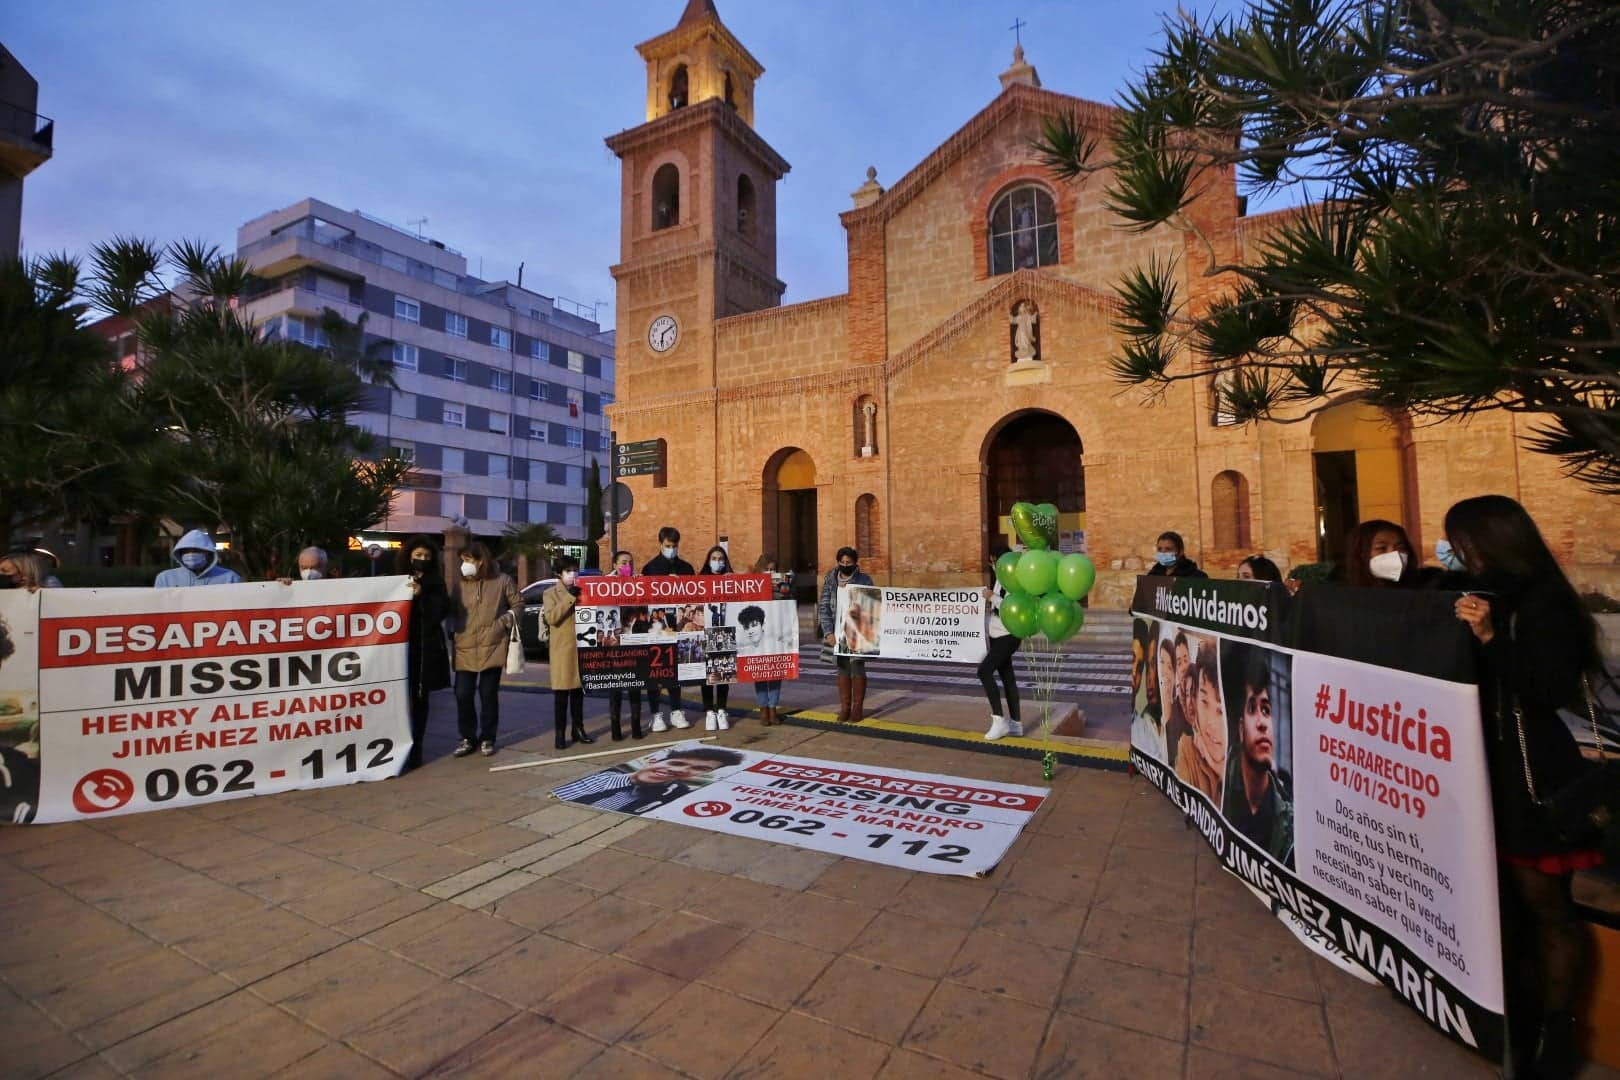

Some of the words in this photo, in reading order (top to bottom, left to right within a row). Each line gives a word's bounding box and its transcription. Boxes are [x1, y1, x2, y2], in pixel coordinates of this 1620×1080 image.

[586, 581, 645, 597] TODOS
[650, 580, 707, 596] SOMOS
[712, 579, 765, 594] HENRY
[886, 591, 979, 603] DESAPARECIDO
[886, 603, 932, 614] MISSING
[934, 604, 979, 615] PERSON
[57, 610, 402, 657] DESAPARECIDO
[904, 616, 960, 626] 01/01/2019
[908, 629, 949, 637] ALEJANDRO
[114, 651, 362, 702] MISSING
[650, 646, 675, 666] 21
[743, 664, 775, 672] ORIHUELA
[775, 662, 796, 670] COSTA
[747, 655, 792, 664] DESAPARECIDO
[82, 707, 200, 736] HENRY
[210, 688, 387, 723] ALEJANDRO
[1315, 683, 1452, 762] #Justicia
[112, 727, 258, 759] JIMÉNEZ
[269, 714, 364, 742] MARÍN
[145, 760, 255, 802] 062
[269, 769, 287, 780] -
[302, 738, 394, 780] 112
[758, 762, 1027, 806] DESAPARECIDO
[1319, 734, 1440, 798] DESARARECIDO
[731, 785, 811, 803] HENRY
[818, 799, 984, 831] ALEJANDRO
[767, 778, 972, 815] MISSING
[1330, 762, 1426, 819] 01/01/2019
[729, 809, 826, 836] 062
[866, 833, 972, 863] 112
[853, 814, 949, 838] MARÍN
[1335, 799, 1354, 820] Dos
[1357, 811, 1384, 834] años
[1387, 824, 1406, 843] sin
[1409, 833, 1424, 853] ti,
[1316, 810, 1325, 824] tu
[1327, 817, 1363, 846] madre,
[1365, 834, 1384, 854] tus
[1387, 842, 1453, 894] hermanos,
[1333, 840, 1375, 869] amigos
[1378, 862, 1385, 877] y
[1388, 867, 1434, 901] vecinos
[1131, 752, 1164, 790] HENRY
[1226, 840, 1337, 942] JIMÉNEZ
[1341, 917, 1479, 1049] MARÍN
[1313, 864, 1362, 901] necesitan
[1365, 893, 1398, 920] saber
[1401, 912, 1421, 937] que
[1424, 930, 1434, 948] te
[1437, 940, 1470, 976] pasó.
[1315, 849, 1366, 883] necesitan
[1368, 875, 1402, 902] saber
[1405, 890, 1416, 912] la
[1418, 903, 1460, 946] verdad,
